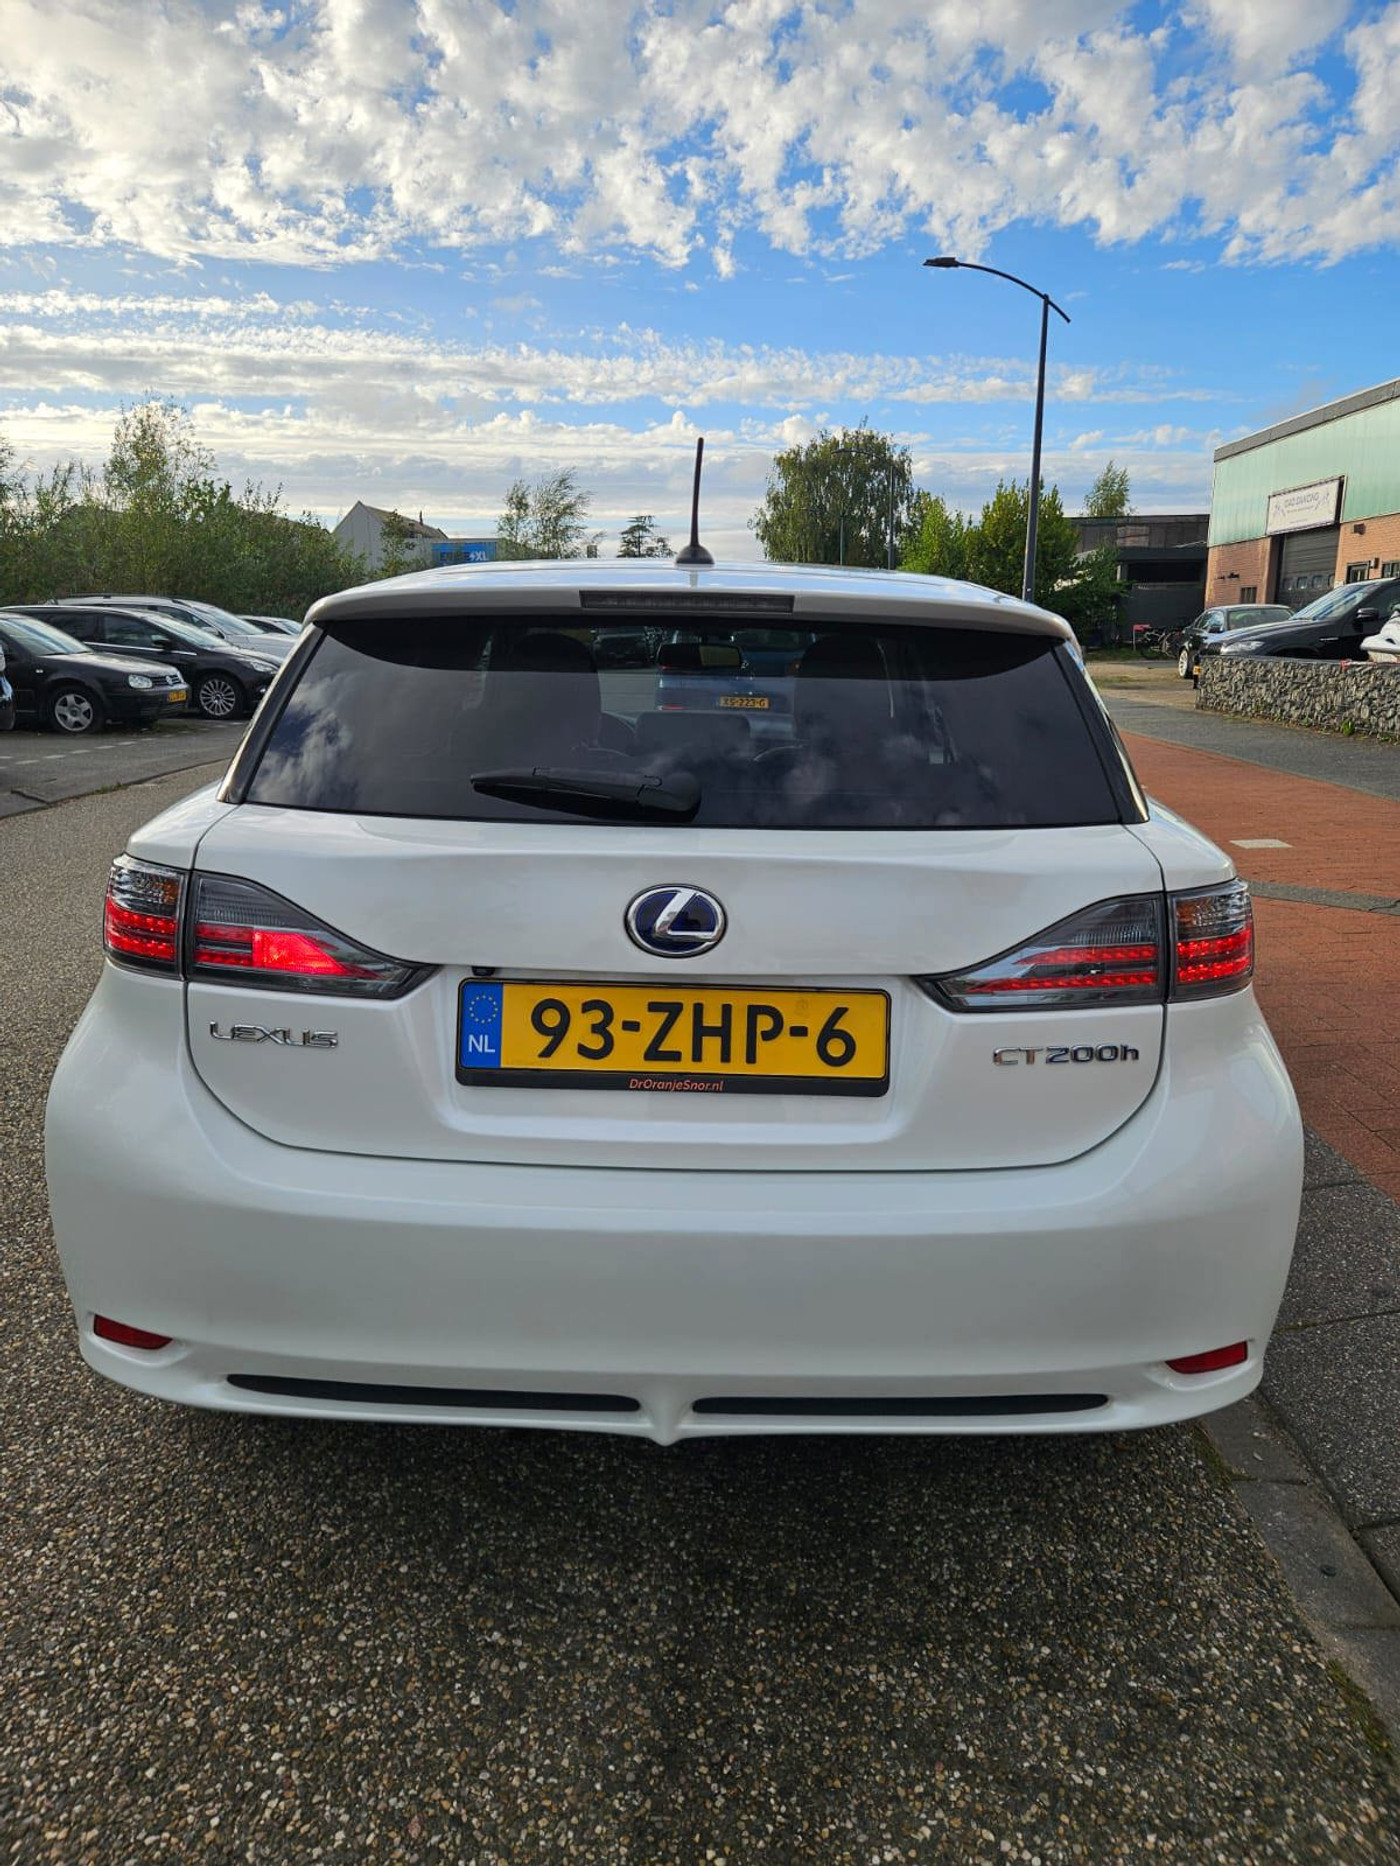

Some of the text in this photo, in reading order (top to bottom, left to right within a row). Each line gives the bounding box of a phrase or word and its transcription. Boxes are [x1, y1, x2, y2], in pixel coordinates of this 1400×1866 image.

[210, 1021, 338, 1048] LEXUS
[469, 997, 857, 1068] NL 93-ZHP-6
[993, 1044, 1139, 1066] CT200h
[628, 1078, 724, 1092] DrOranjeSnor.nl
